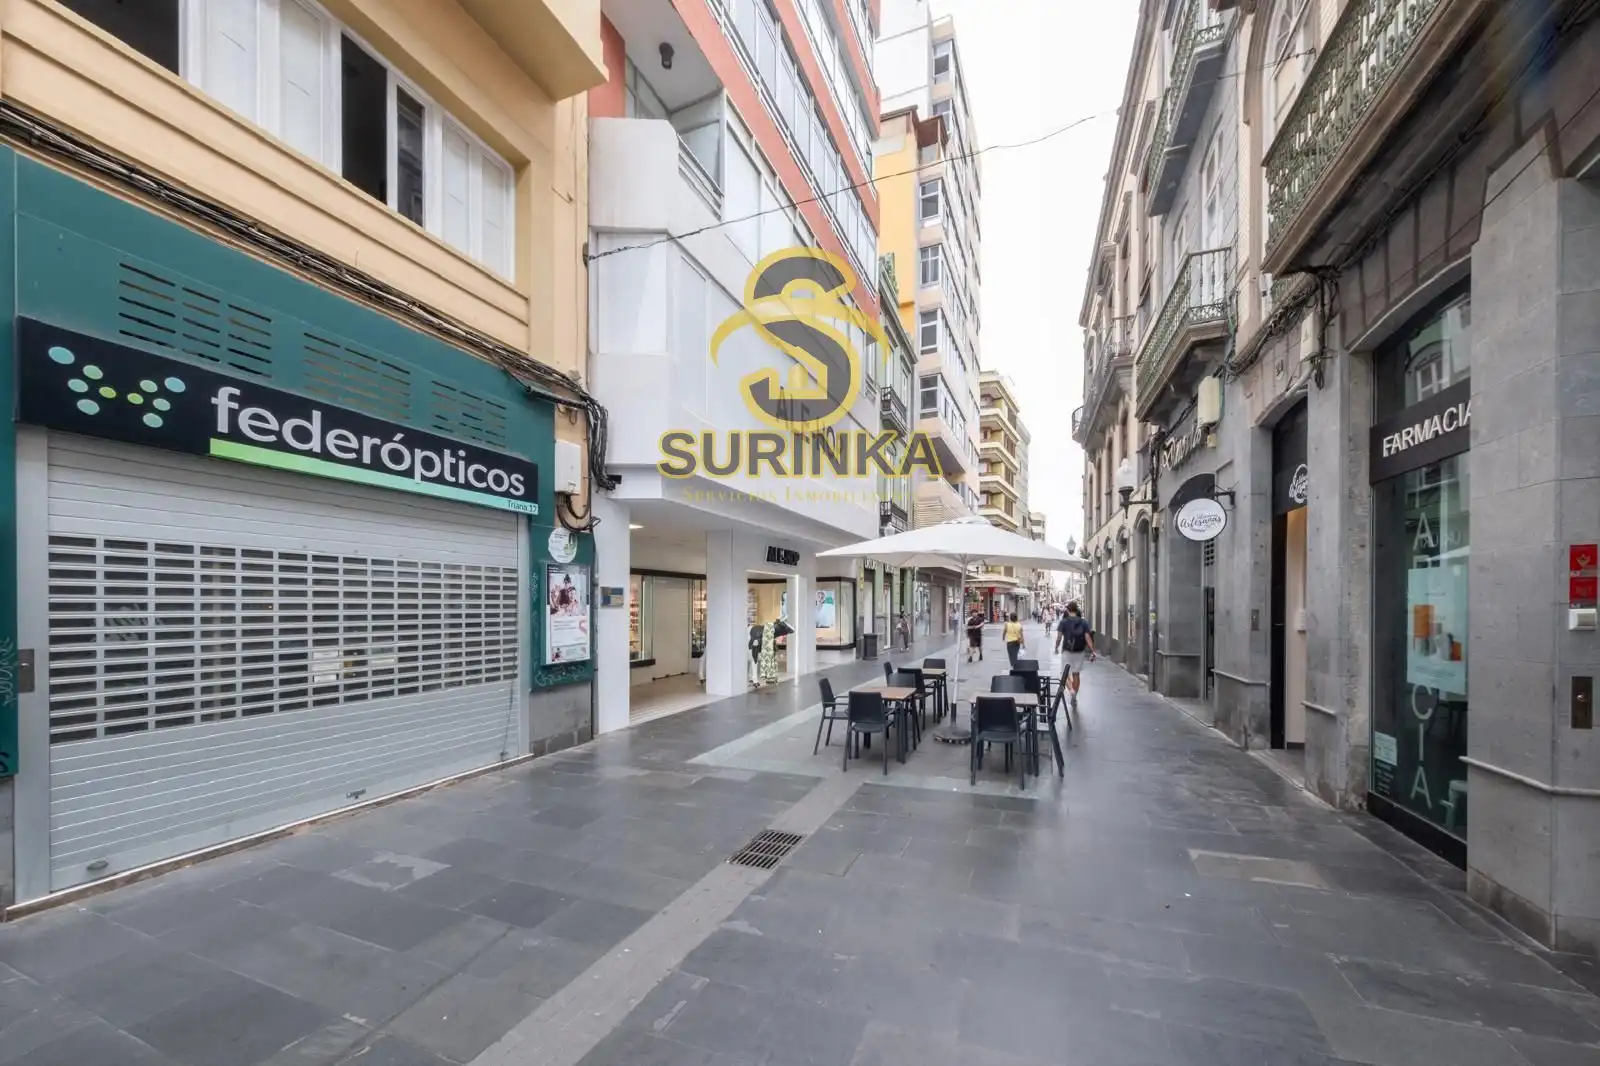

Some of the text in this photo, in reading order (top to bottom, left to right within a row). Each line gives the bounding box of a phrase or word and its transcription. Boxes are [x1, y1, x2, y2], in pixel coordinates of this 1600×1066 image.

[210, 386, 526, 496] federópticos
[1383, 400, 1471, 458] FARMACIA
[508, 500, 528, 511] Triana
